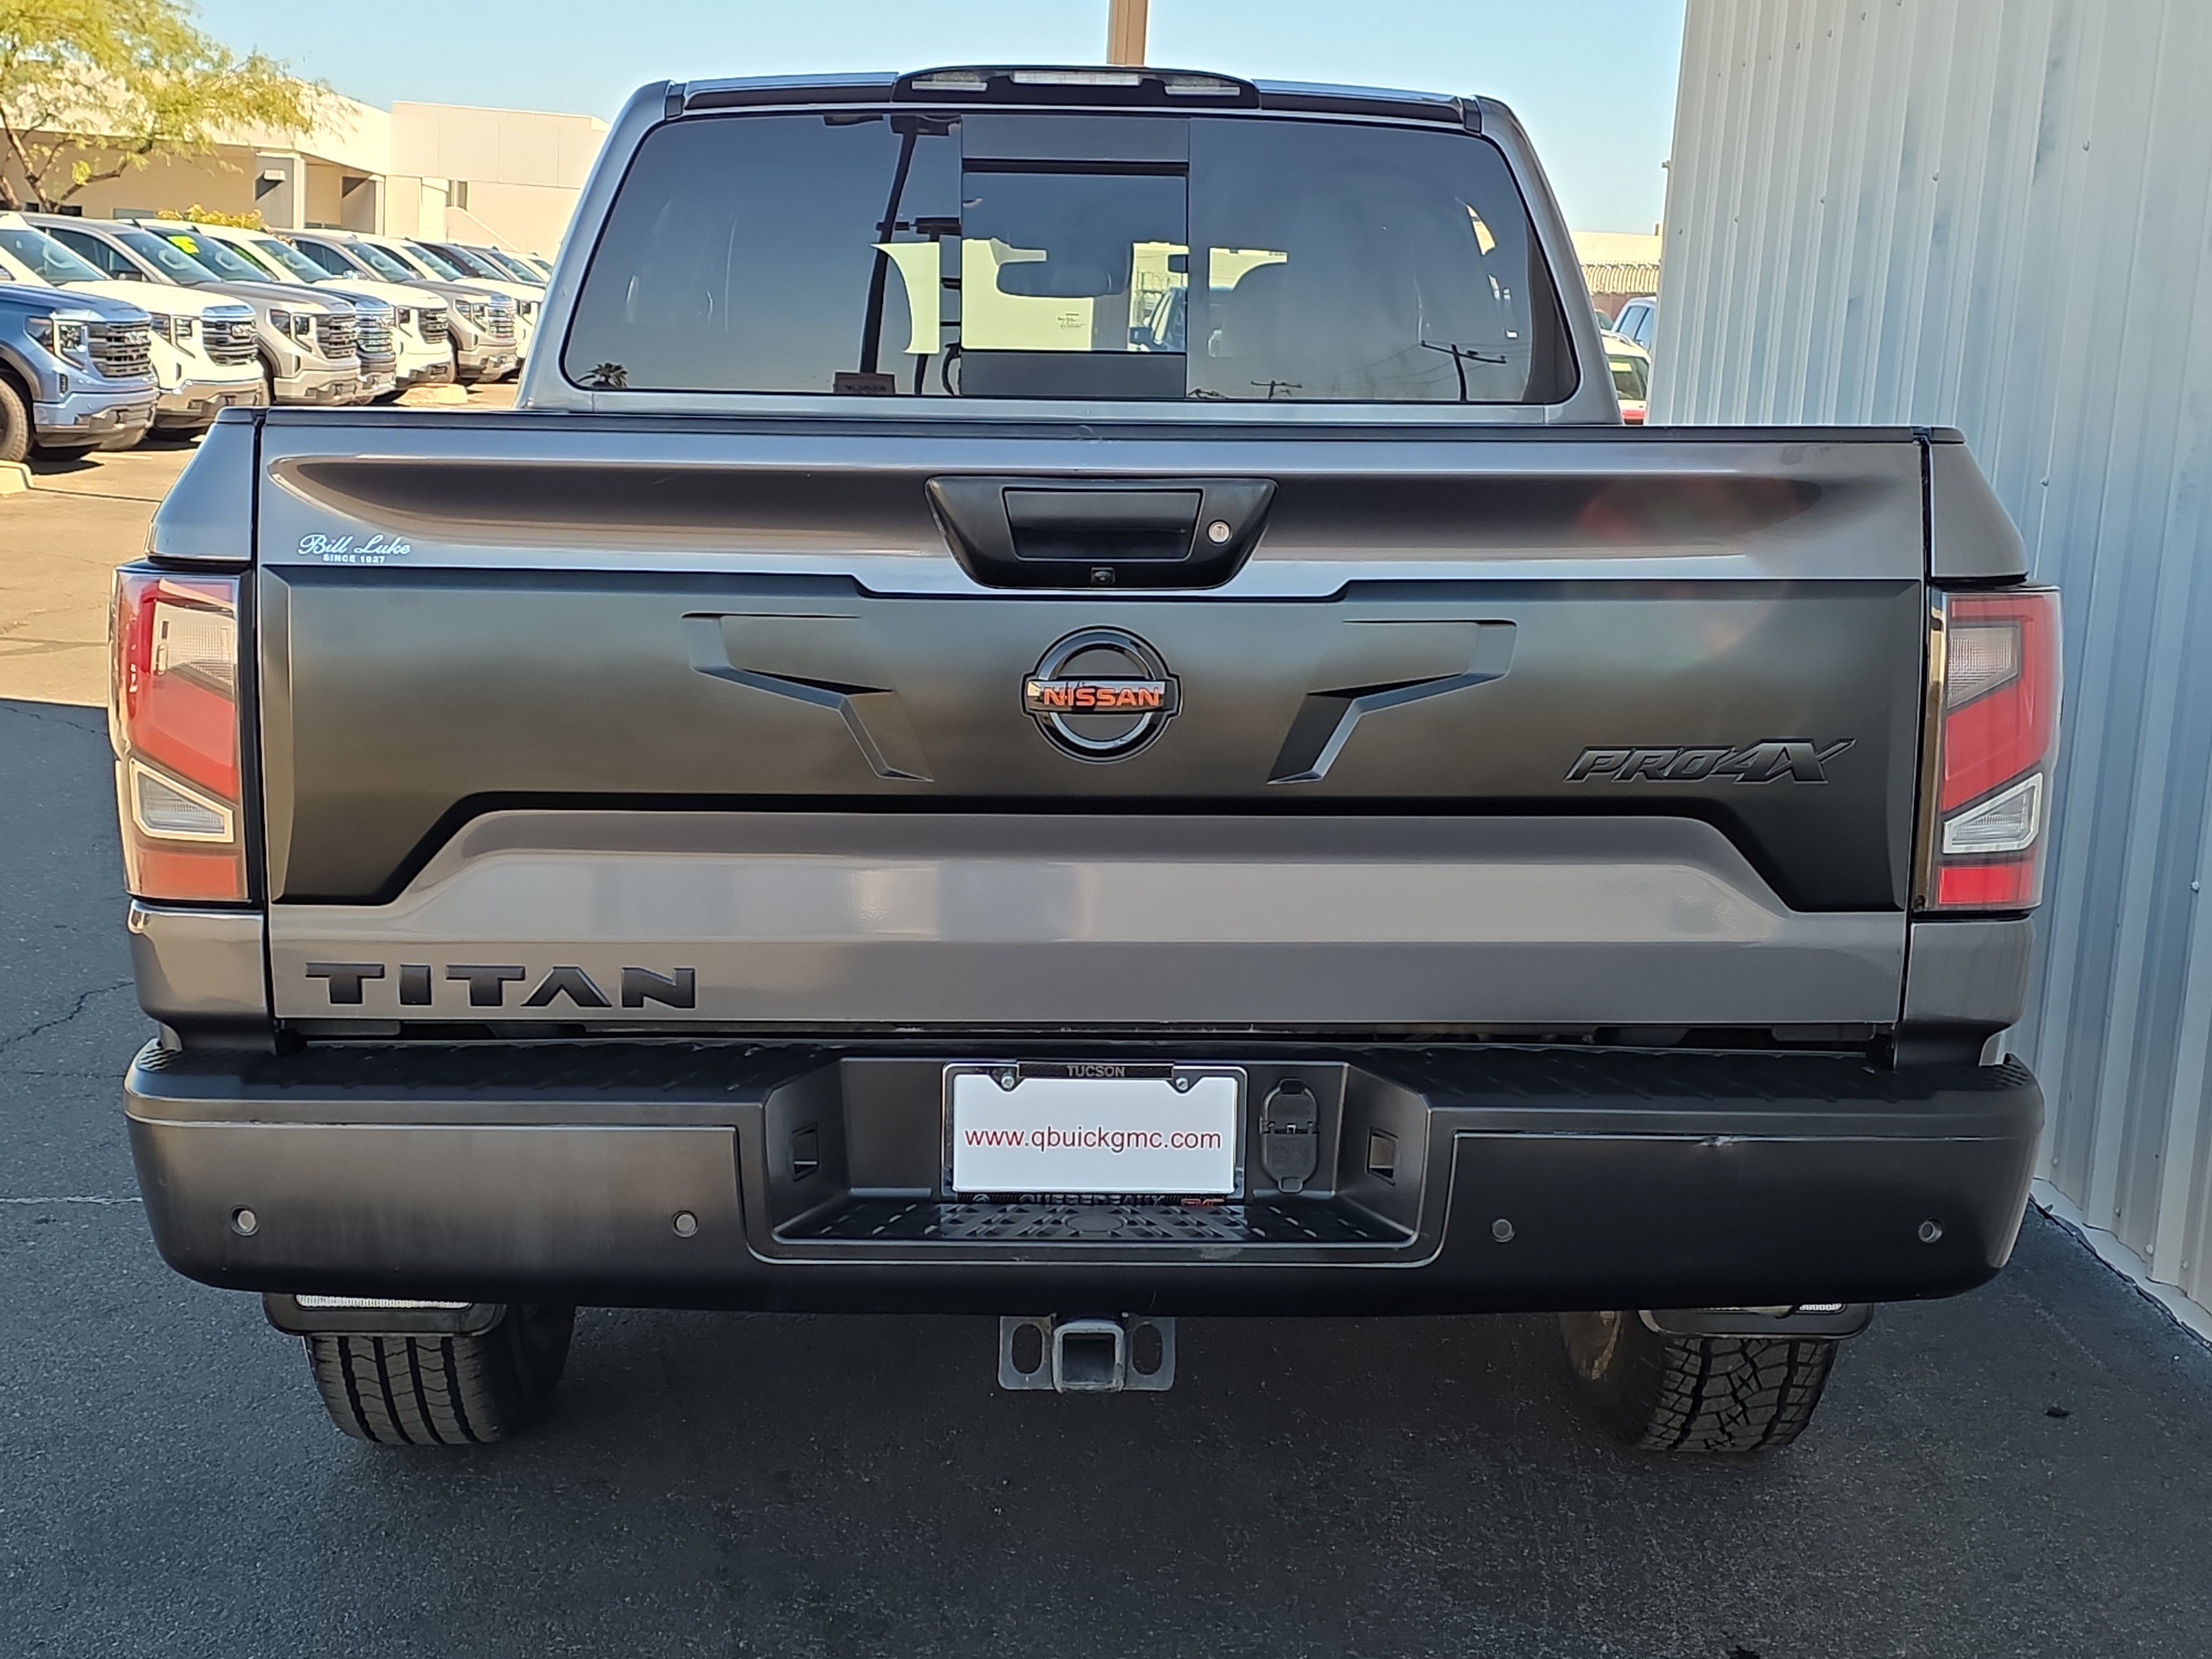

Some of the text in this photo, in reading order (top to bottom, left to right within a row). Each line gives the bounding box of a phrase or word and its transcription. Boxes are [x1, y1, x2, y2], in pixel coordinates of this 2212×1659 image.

[298, 533, 411, 555] Bill Luke
[323, 554, 356, 563] SINCE
[1043, 687, 1160, 706] NISSAN
[305, 962, 696, 1008] TITAN
[1067, 1065, 1125, 1077] TUCSON
[965, 1126, 1221, 1152] www.qbuickgmc.com
